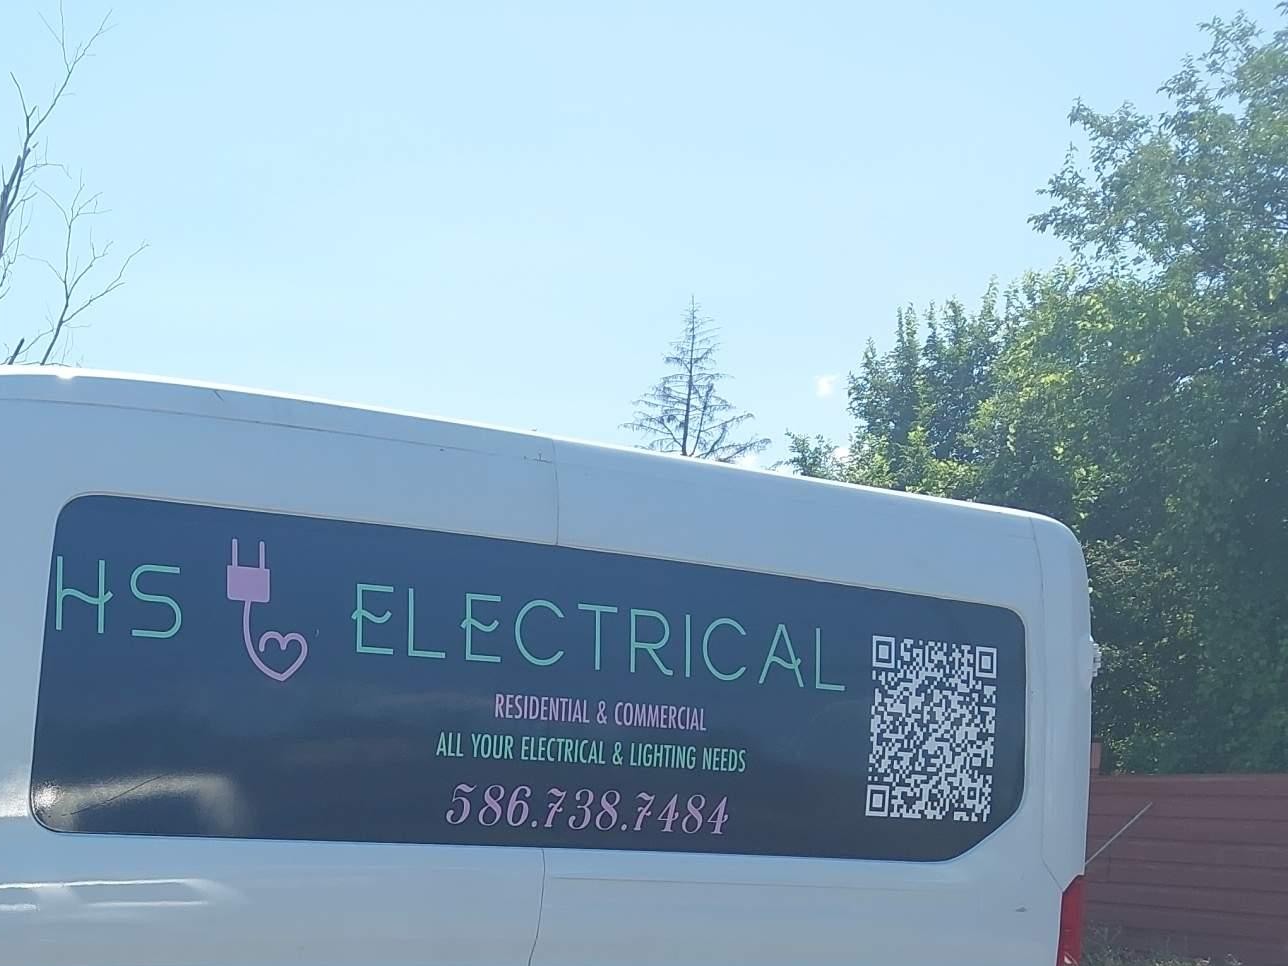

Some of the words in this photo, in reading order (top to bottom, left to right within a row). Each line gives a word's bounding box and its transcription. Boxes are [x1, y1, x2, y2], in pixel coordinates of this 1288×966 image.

[54, 555, 182, 640] HS
[352, 582, 846, 692] ELECTRICAL
[494, 693, 591, 725] RESIDENTIAL
[596, 700, 609, 725] &
[614, 702, 708, 732] COMMERCIAL
[435, 732, 465, 758] ALL
[471, 733, 515, 761] YOUR
[520, 736, 607, 766] ELECTRICAL
[611, 742, 624, 766] &
[629, 743, 698, 771] LIGHTING
[702, 748, 747, 774] NEEDS
[445, 783, 730, 836] 586.738.7484
